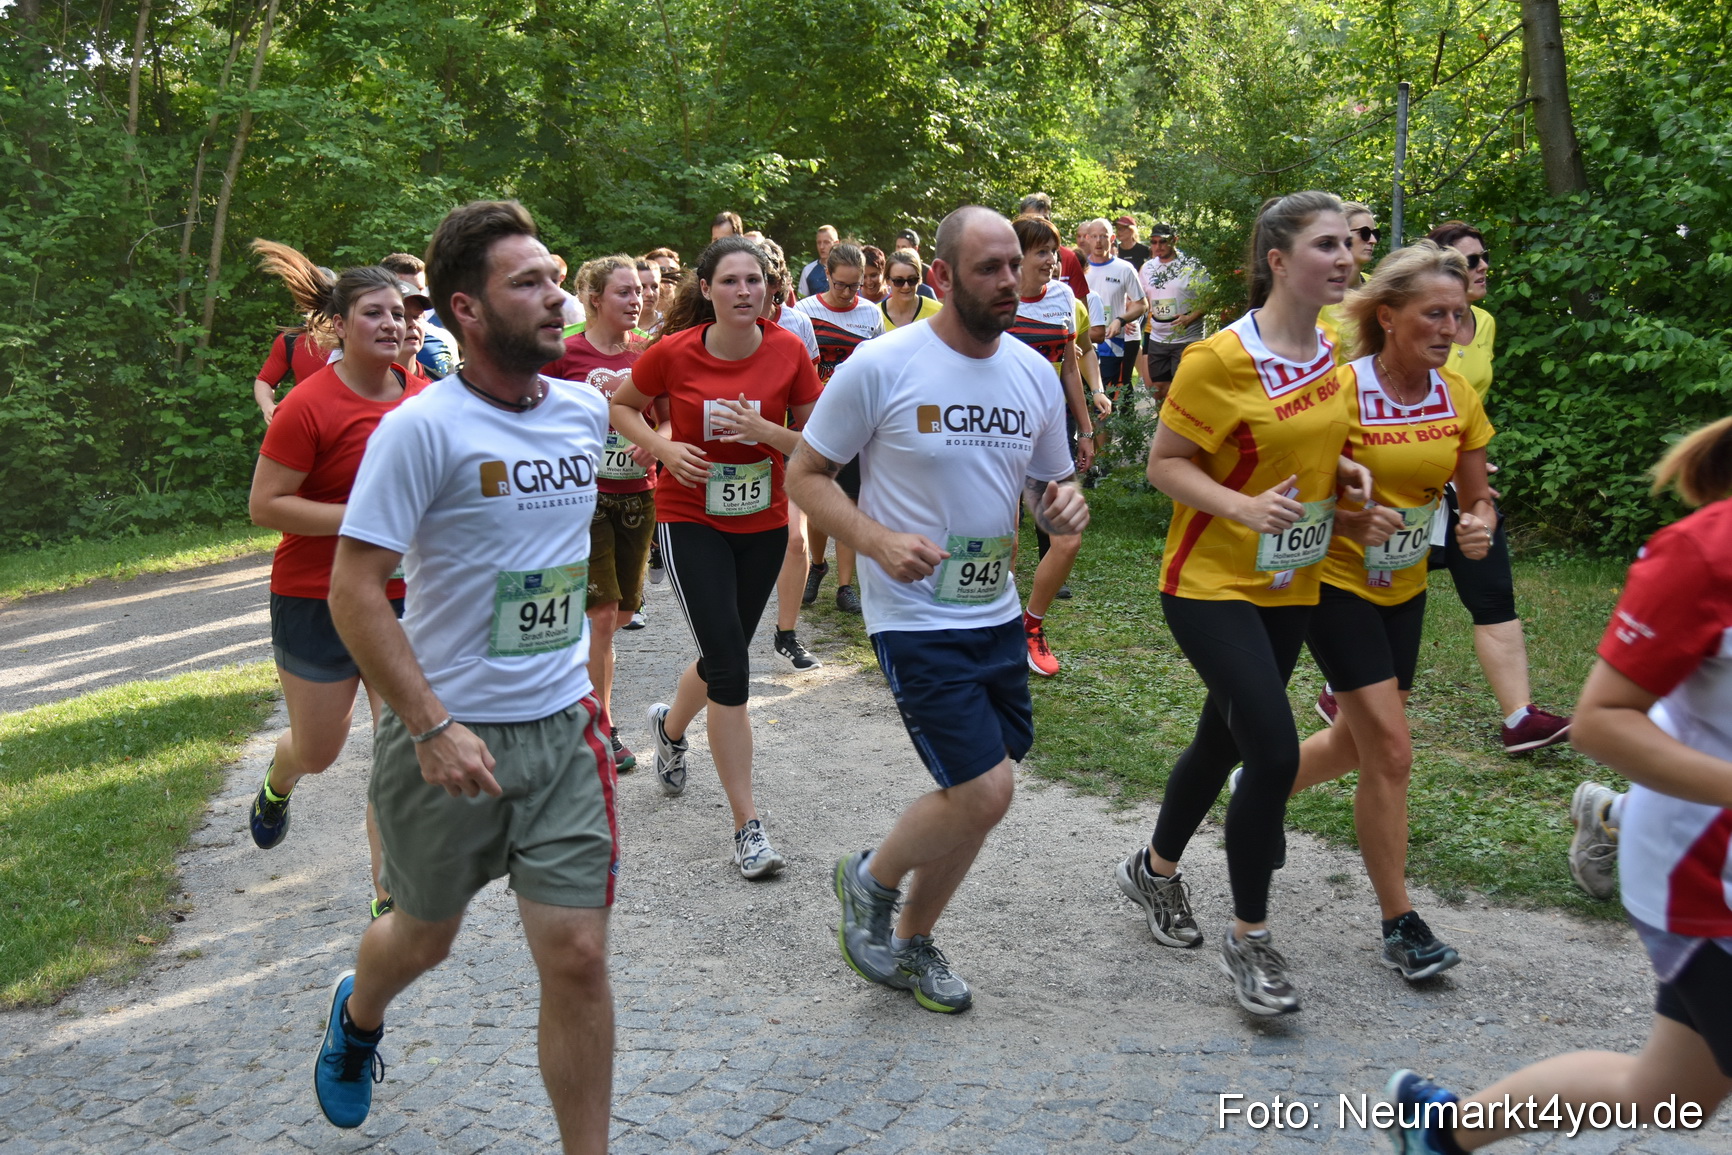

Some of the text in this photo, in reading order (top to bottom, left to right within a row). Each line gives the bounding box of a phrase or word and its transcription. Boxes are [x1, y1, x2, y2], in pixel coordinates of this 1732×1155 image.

[1156, 306, 1170, 315] 345
[1274, 376, 1341, 421] MAX BÖG
[931, 421, 941, 432] R
[944, 404, 1032, 438] GRADL
[1361, 431, 1411, 446] MAX
[605, 450, 634, 467] 701
[497, 481, 509, 495] R
[722, 481, 761, 502] 515
[1273, 522, 1327, 552] 1600
[959, 561, 1001, 586] 943
[519, 595, 570, 632] 941
